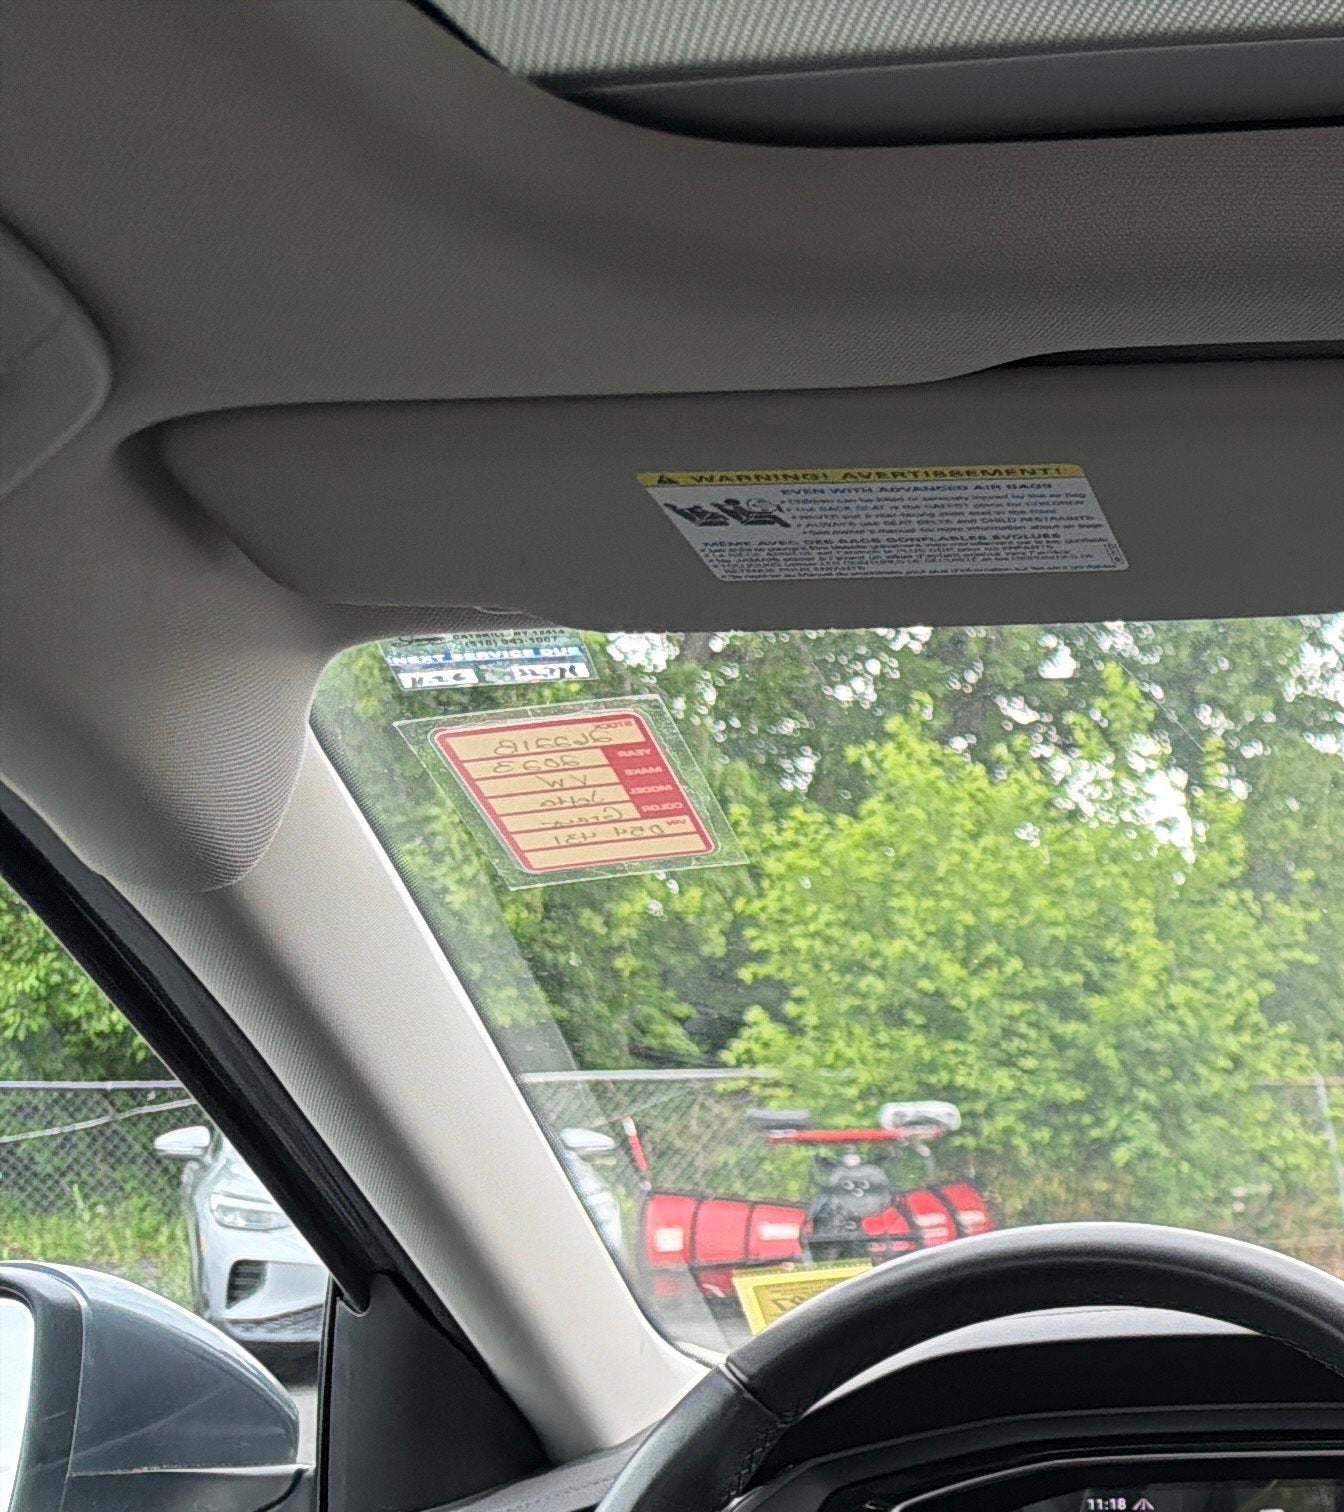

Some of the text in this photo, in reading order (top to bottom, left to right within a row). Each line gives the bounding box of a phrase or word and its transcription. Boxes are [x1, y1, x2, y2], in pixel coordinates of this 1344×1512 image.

[690, 468, 1062, 483] WARNING! AVERTISSEMENT!
[781, 488, 823, 496] EVEN
[828, 486, 871, 494] WITH
[879, 484, 968, 493] ADVANCED
[1006, 482, 1053, 490] BAGS
[390, 646, 582, 665] NEXT SERVICE DUE
[1087, 1498, 1127, 1511] 11:18
